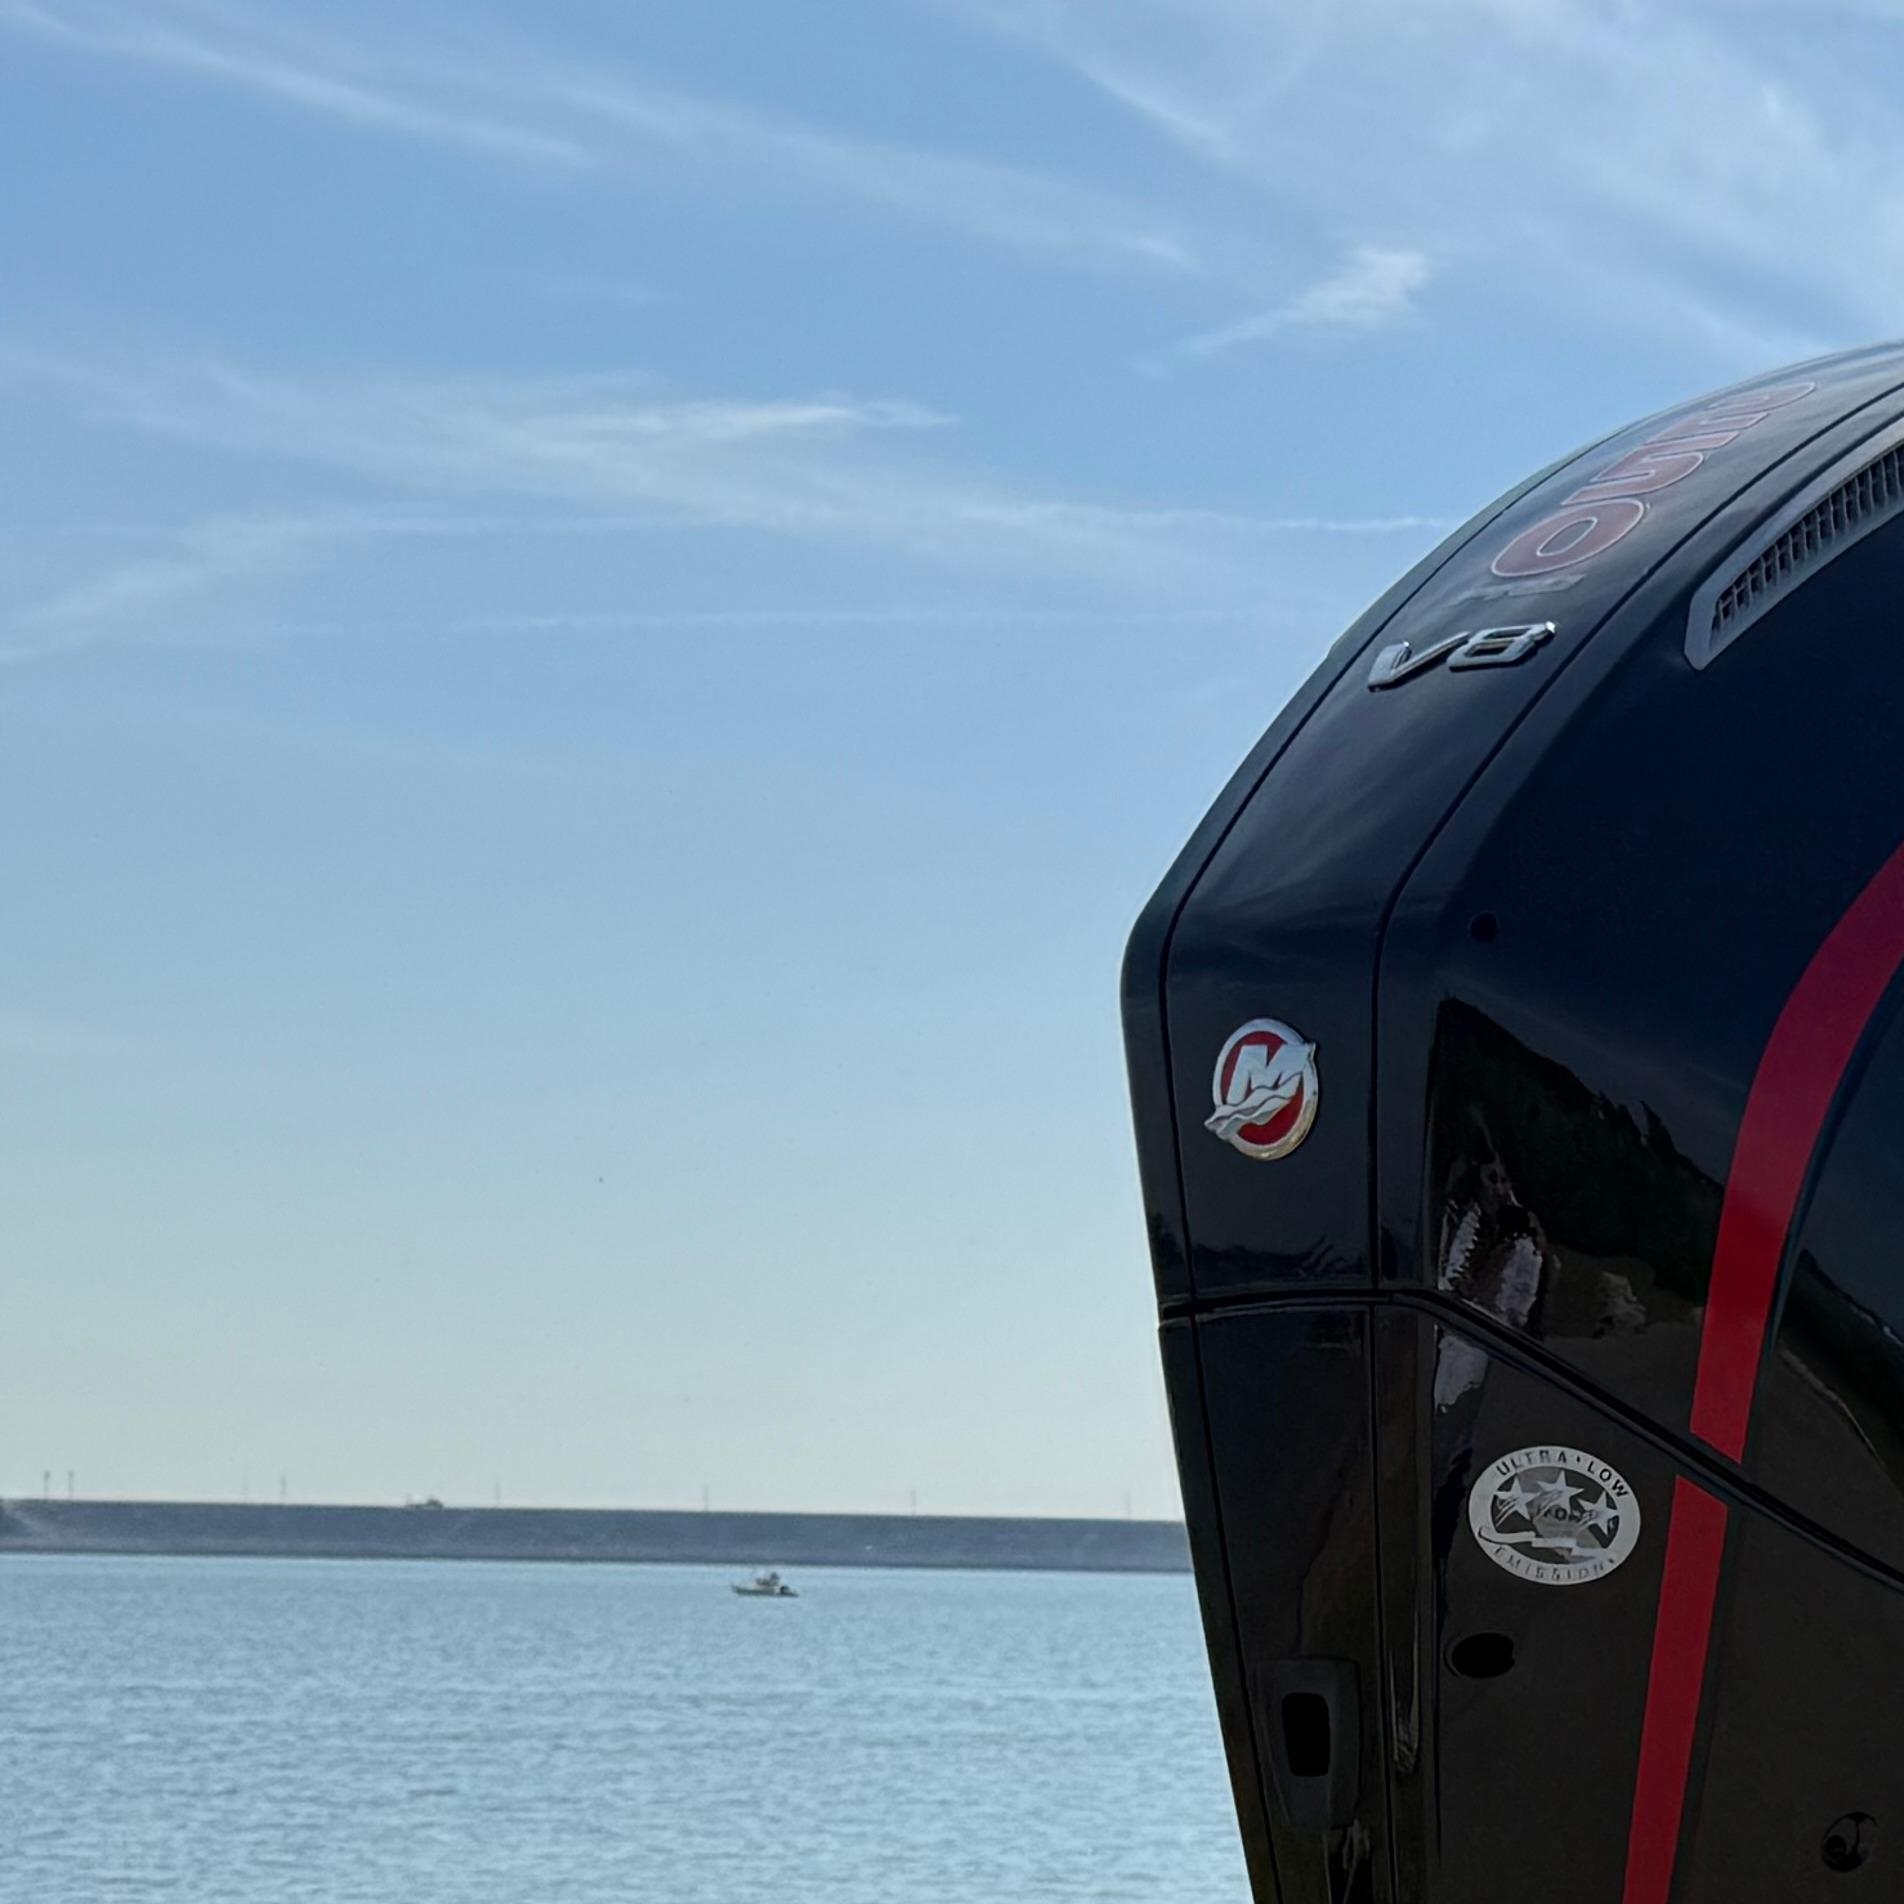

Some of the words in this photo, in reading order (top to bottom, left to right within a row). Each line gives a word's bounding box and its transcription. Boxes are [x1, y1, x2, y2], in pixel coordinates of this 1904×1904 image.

[1368, 621, 1557, 693] V8
[1495, 1449, 1569, 1478] ULTRA
[1587, 1461, 1635, 1500] LOW
